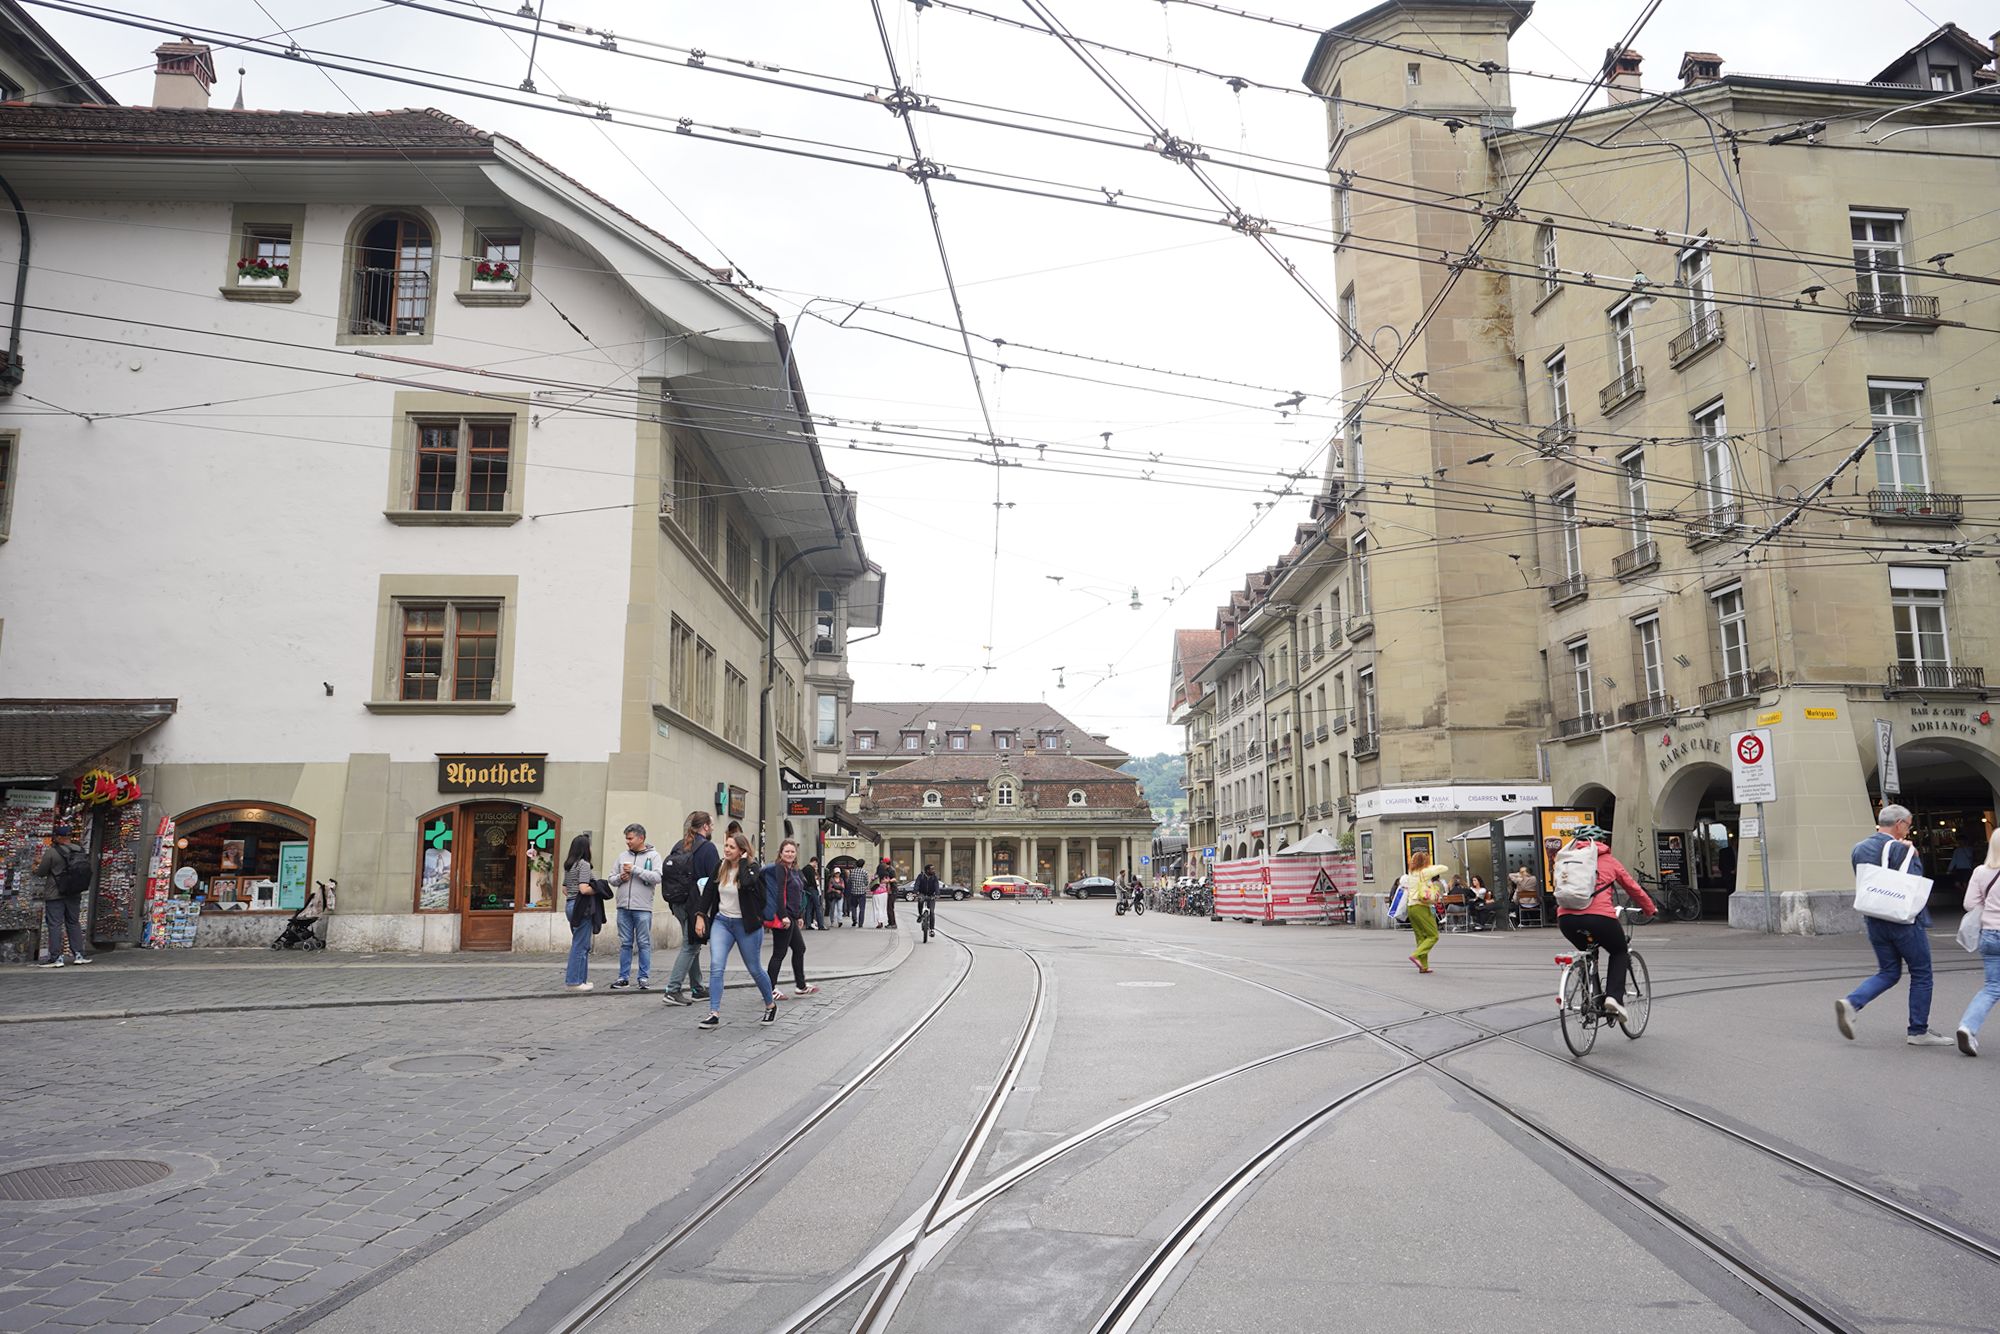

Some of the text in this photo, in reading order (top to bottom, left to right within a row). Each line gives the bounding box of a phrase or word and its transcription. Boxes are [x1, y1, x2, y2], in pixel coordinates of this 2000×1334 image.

[1806, 710, 1835, 718] Marktgasse
[1911, 708, 1967, 717] BAR & CAFE
[1911, 721, 1977, 736] ADRIANO'S
[1660, 748, 1680, 771] BAR
[1690, 738, 1721, 754] CAFE
[446, 762, 537, 788] Apotheke
[1206, 848, 1212, 856] P
[1866, 886, 1906, 900] CANDIDA
